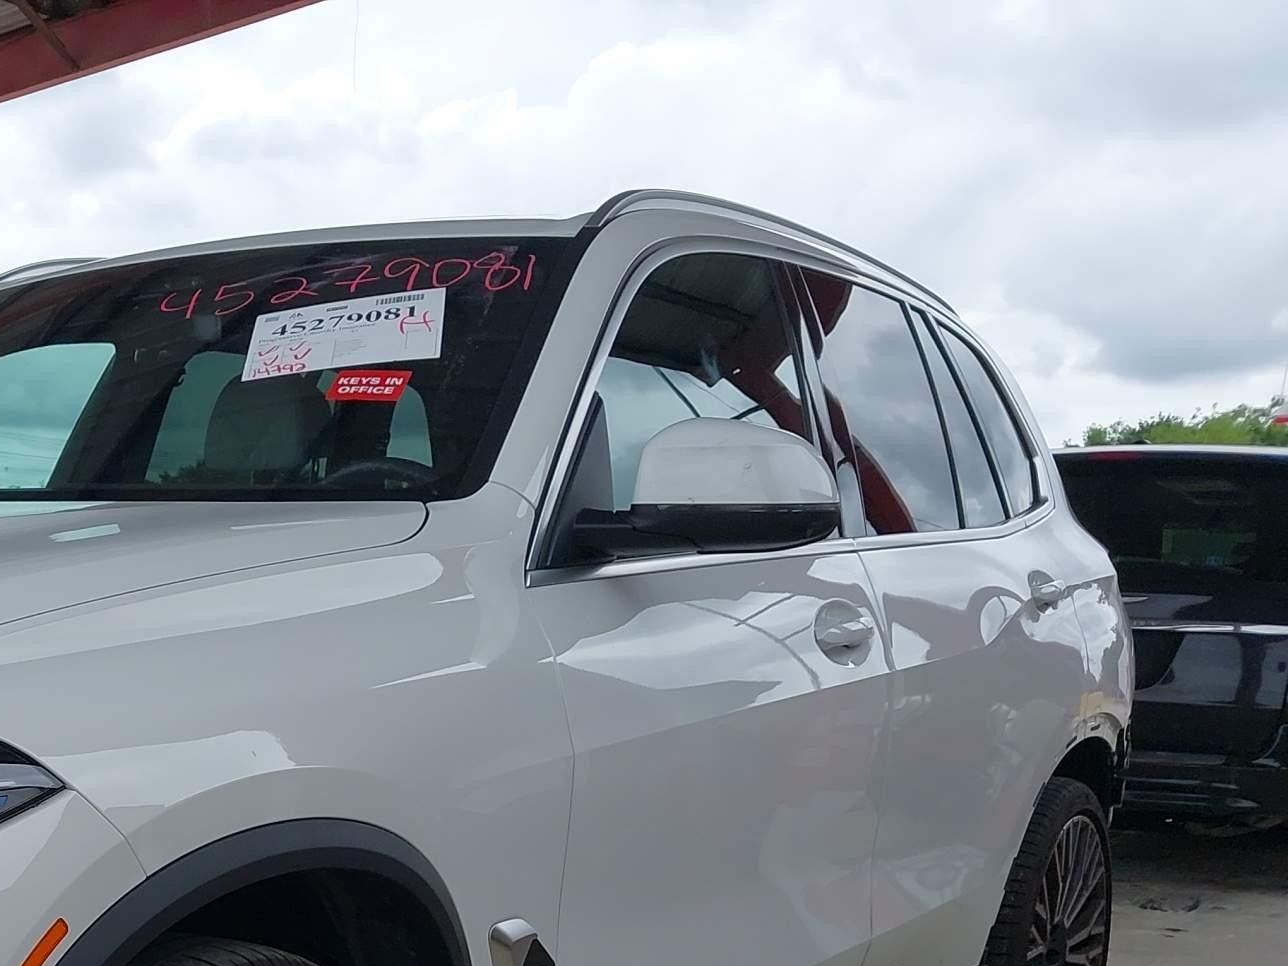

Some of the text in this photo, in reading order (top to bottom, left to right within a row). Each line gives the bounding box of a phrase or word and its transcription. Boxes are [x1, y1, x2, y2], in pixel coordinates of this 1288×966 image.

[160, 252, 537, 319] 45279081
[272, 305, 416, 337] 45279081
[337, 376, 404, 386] KEYS IN
[337, 385, 394, 395] OFFICE
